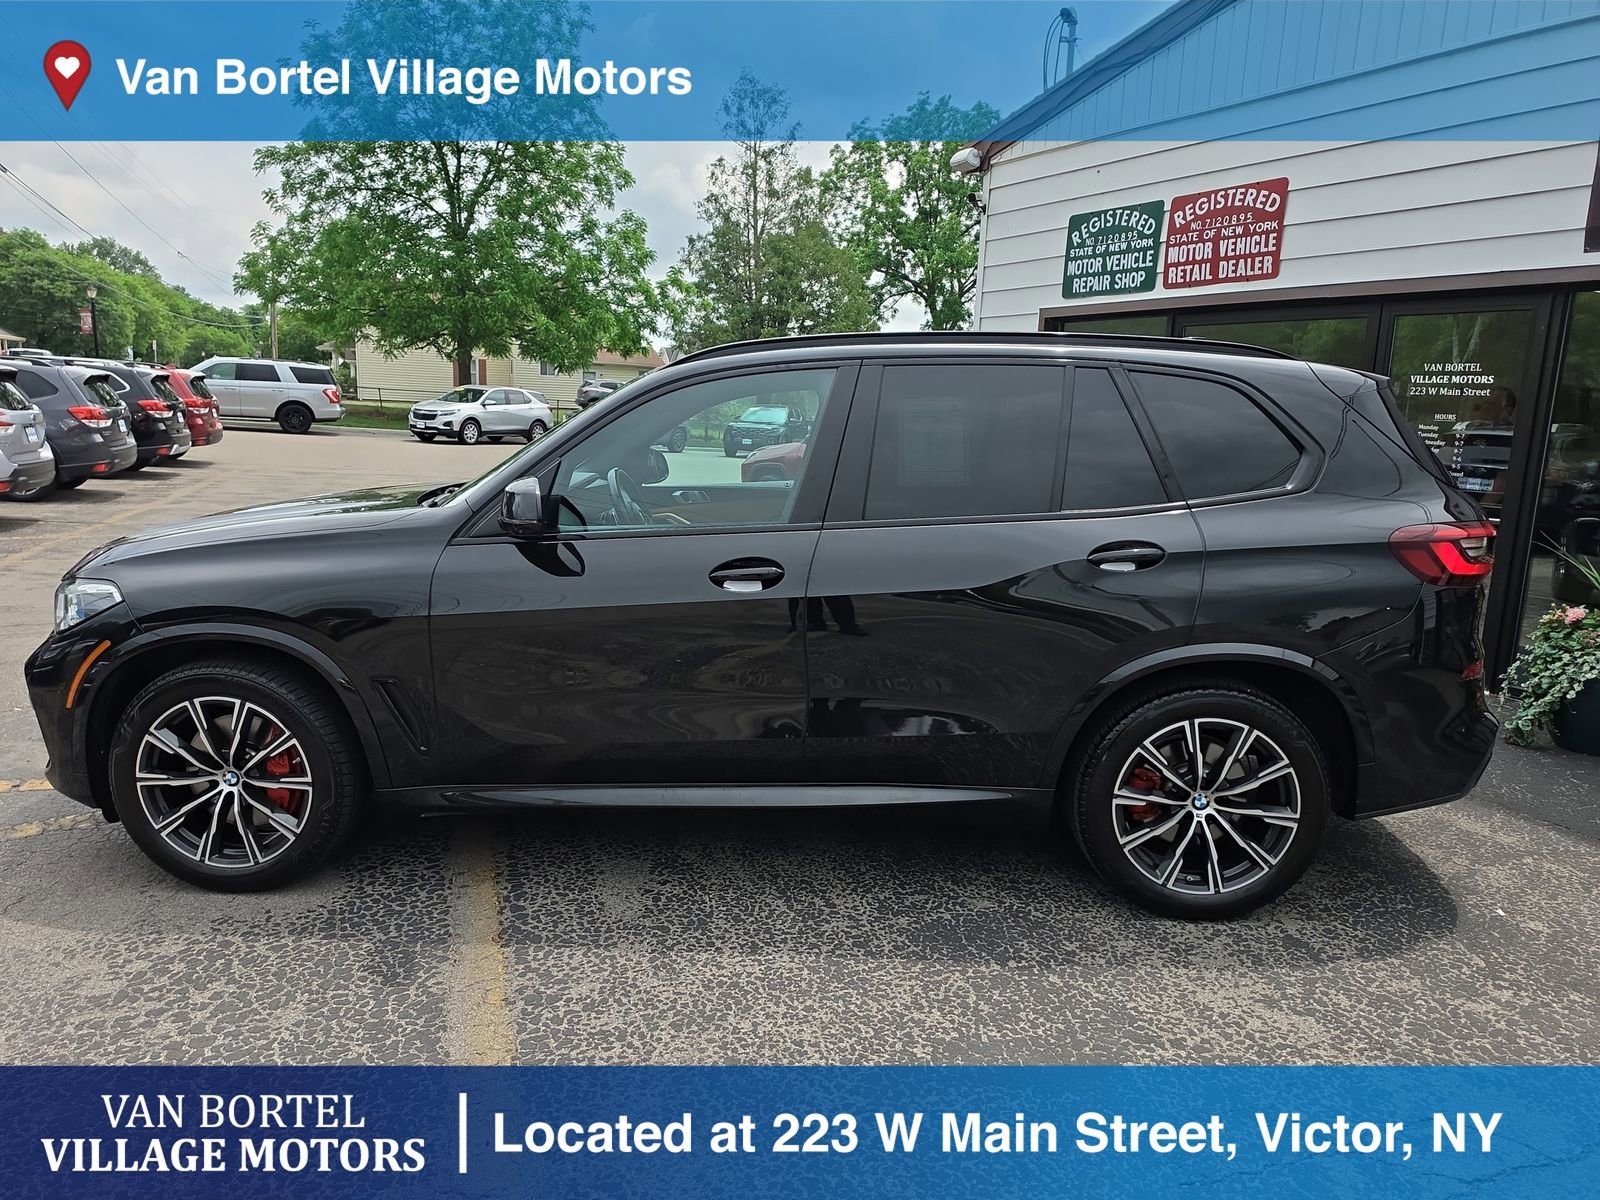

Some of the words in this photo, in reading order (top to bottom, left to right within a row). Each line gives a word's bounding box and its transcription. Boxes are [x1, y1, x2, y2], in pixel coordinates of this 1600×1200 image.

[1174, 189, 1280, 228] REGISTERED
[1072, 210, 1156, 246] REGISTERED
[1190, 221, 1202, 230] NO.
[1205, 212, 1253, 228] 7120895
[1098, 231, 1138, 244] 7120895
[1169, 232, 1199, 244] STATE
[1204, 229, 1217, 239] OF
[1221, 226, 1244, 237] NEW
[1248, 220, 1278, 233] YORK
[1070, 246, 1093, 257] STATE
[1096, 245, 1106, 254] OF
[1109, 242, 1128, 252] NEW
[1130, 238, 1154, 249] YORK
[1168, 242, 1213, 264] MOTOR
[1220, 233, 1278, 257] VEHICLE
[1067, 257, 1103, 276] MOTOR
[1106, 250, 1154, 271] VEHICLE
[1168, 263, 1212, 284] RETAIL
[1218, 256, 1273, 278] DEALER
[1072, 274, 1111, 294] REPAIR
[1114, 271, 1146, 289] SHOP
[1424, 363, 1443, 372] VAN
[1445, 363, 1482, 372] BORTEL
[1410, 375, 1449, 384] VILLAGE
[1451, 375, 1494, 384] MOTORS
[1410, 387, 1426, 395] 223
[1428, 387, 1438, 395] W
[1440, 387, 1460, 396] Main
[1463, 387, 1491, 396] Street
[1418, 431, 1439, 439] Tuesday
